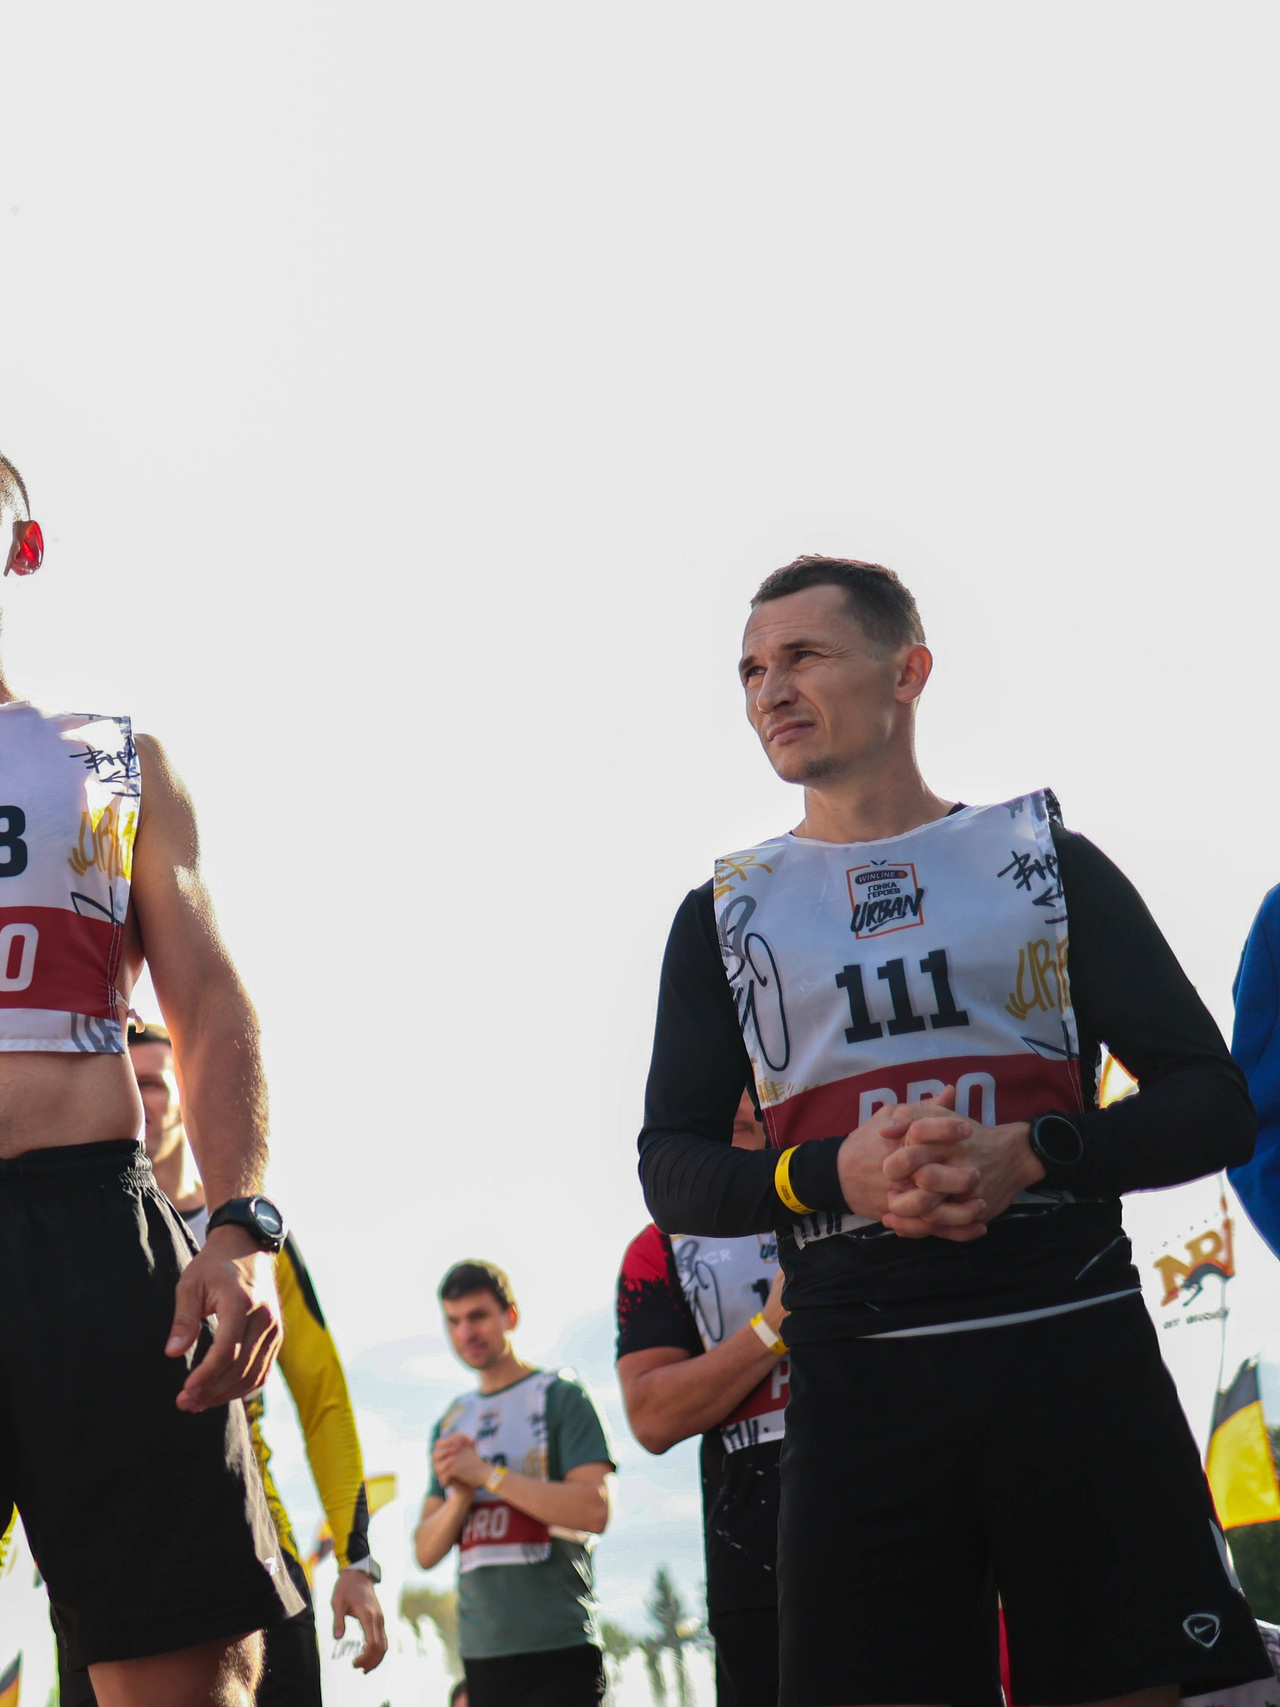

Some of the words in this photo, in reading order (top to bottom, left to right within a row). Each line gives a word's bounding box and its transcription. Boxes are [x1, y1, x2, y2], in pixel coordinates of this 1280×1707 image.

[858, 871, 896, 883] WINLINE
[868, 882, 897, 892] ГОНКА
[867, 888, 901, 900] ГЕРОЕВ
[850, 888, 924, 932] URBAN
[835, 949, 970, 1044] 111
